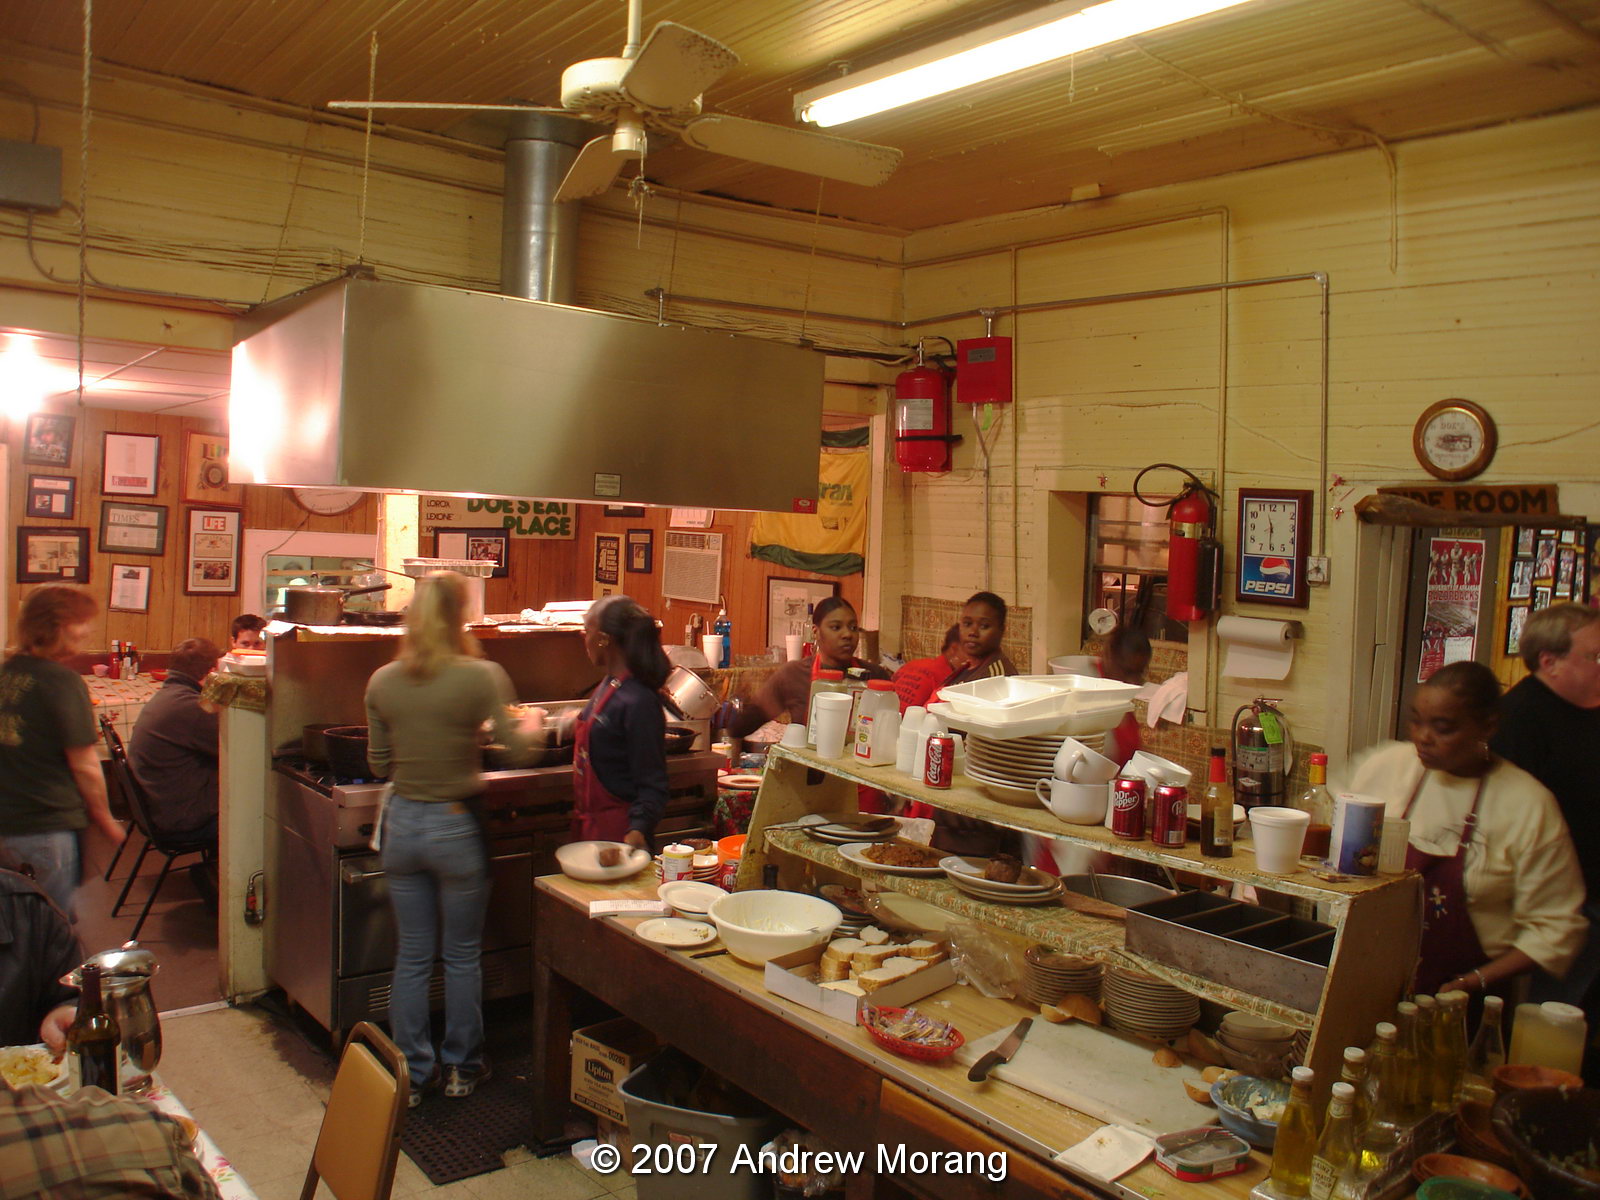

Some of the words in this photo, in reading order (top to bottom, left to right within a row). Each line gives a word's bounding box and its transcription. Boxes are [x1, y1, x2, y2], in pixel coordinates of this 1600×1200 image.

[1454, 488, 1548, 514] ROOM
[1260, 504, 1266, 512] 11
[1270, 504, 1277, 512] 12
[1250, 511, 1258, 519] 10
[502, 515, 571, 536] PLACE
[1245, 580, 1290, 594] PEPSI
[1428, 590, 1479, 600] RAZORBACKS
[1118, 790, 1130, 800] Dr
[587, 1060, 611, 1080] Lipton
